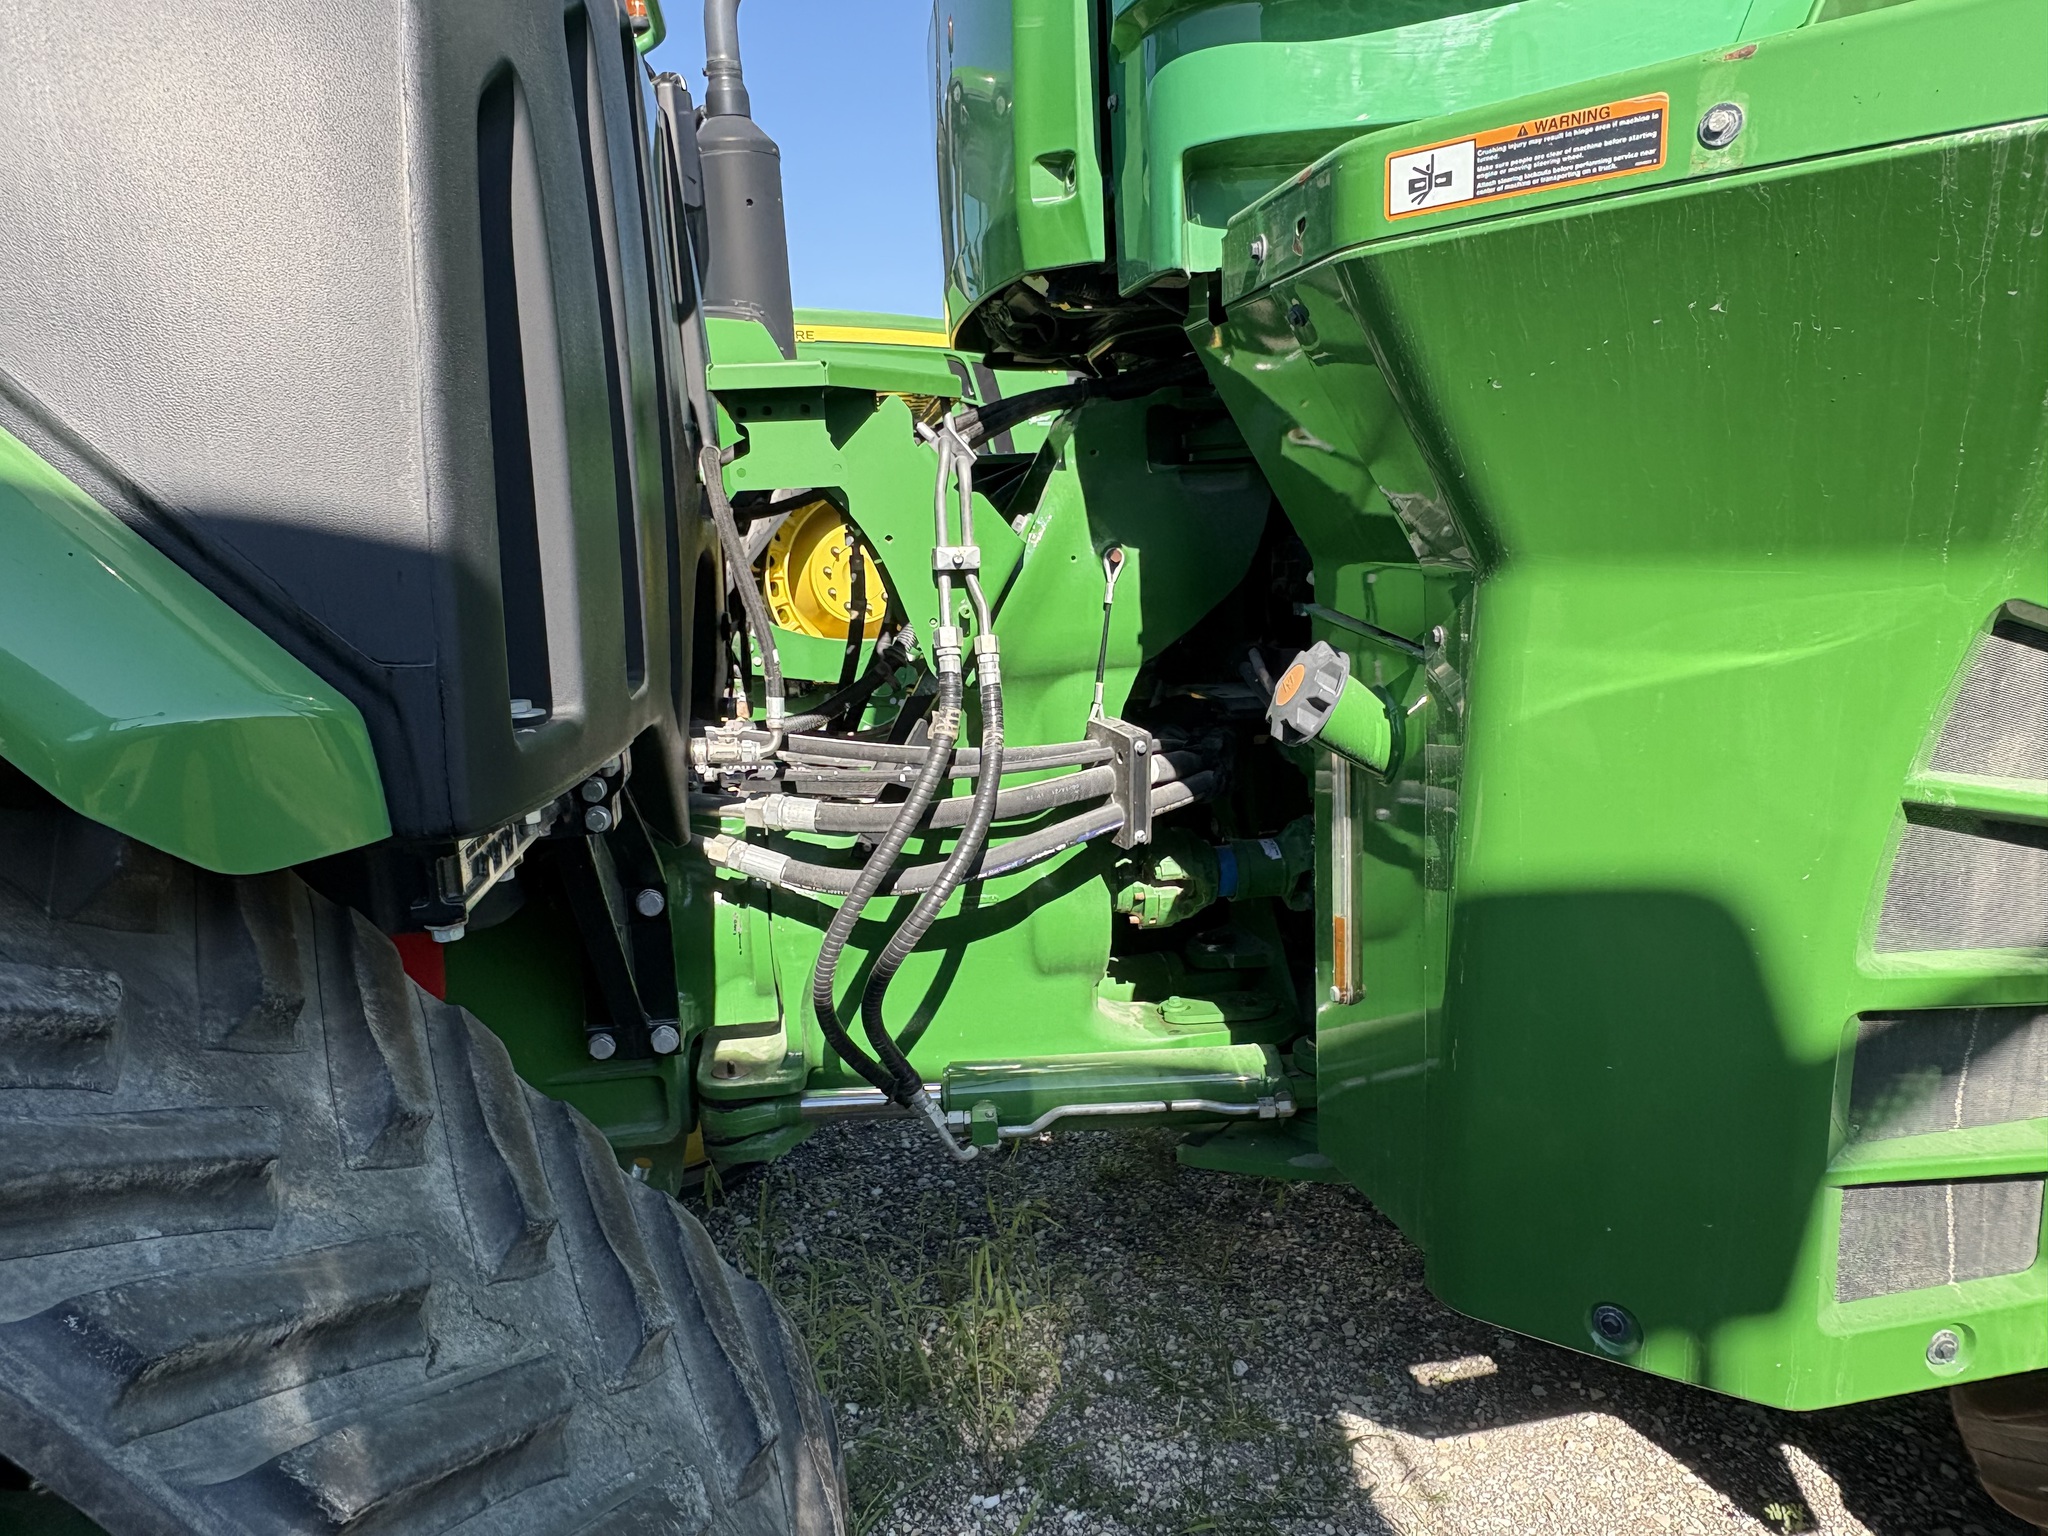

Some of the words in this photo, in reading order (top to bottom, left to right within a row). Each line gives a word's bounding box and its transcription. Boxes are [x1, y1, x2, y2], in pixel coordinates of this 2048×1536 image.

[1534, 106, 1611, 133] WARNING
[1477, 145, 1507, 156] Crushing
[1508, 141, 1527, 150] injury
[1544, 132, 1563, 142] result
[1574, 127, 1593, 136] hinge
[1619, 114, 1650, 126] machine
[1510, 156, 1532, 166] people
[1546, 149, 1563, 158] clear
[1573, 142, 1602, 152] machine
[1604, 137, 1627, 146] before
[1629, 131, 1657, 142] starting
[1477, 170, 1498, 179] engine
[1508, 163, 1532, 173] moving
[1534, 158, 1561, 168] steering
[1553, 164, 1573, 174] before
[1575, 156, 1612, 170] performing
[1613, 152, 1638, 161] service
